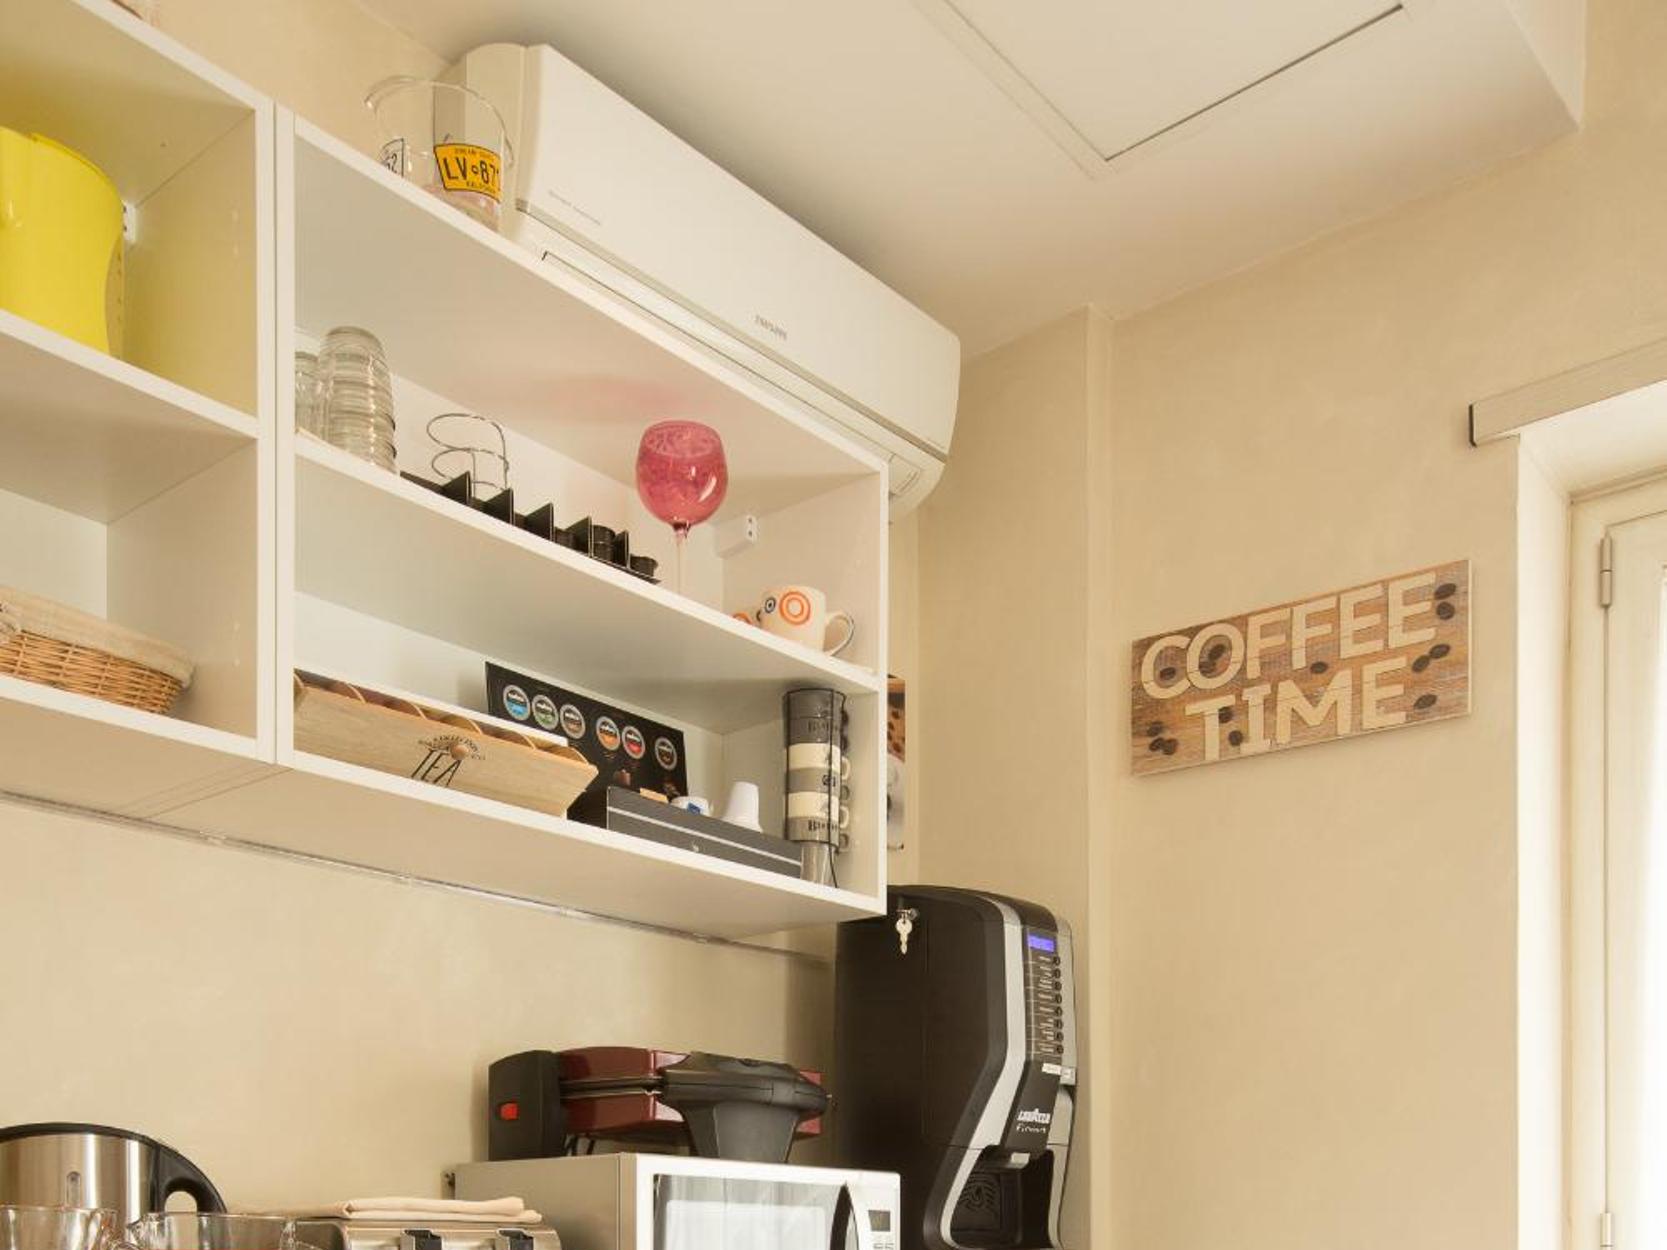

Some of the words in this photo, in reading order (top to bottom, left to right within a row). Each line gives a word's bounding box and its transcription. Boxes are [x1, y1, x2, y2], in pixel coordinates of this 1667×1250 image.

[1141, 572, 1437, 700] COFFEE
[1184, 656, 1408, 762] TIME
[411, 748, 462, 788] TEA
